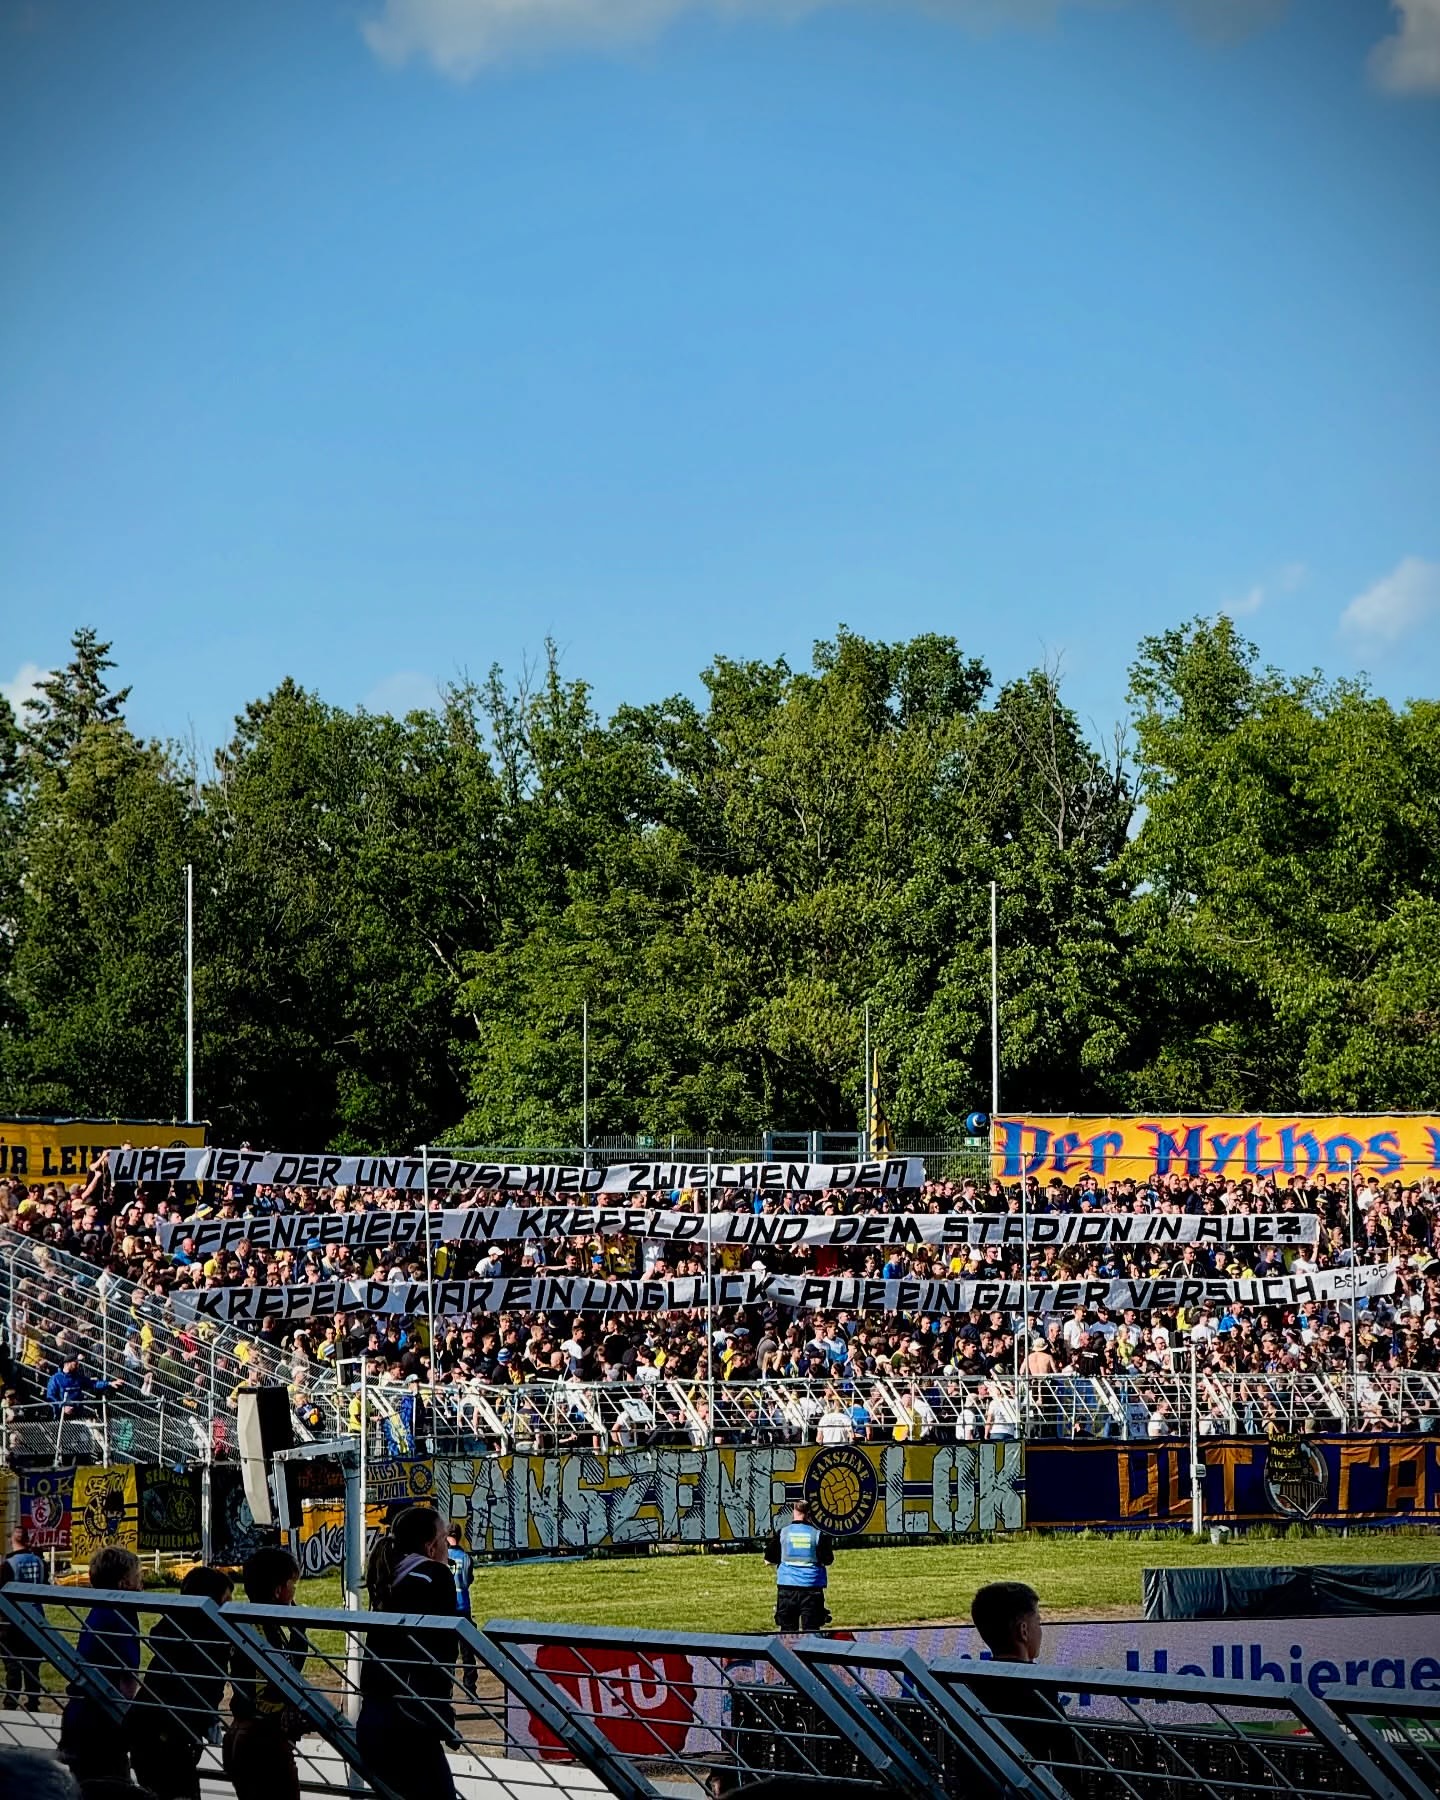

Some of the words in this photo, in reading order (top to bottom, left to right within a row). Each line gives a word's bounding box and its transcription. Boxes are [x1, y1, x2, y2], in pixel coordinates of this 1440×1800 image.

[994, 1119, 1125, 1177] Der
[1136, 1122, 1407, 1178] Mythos
[114, 1151, 186, 1181] WAS
[206, 1151, 264, 1182] IST
[273, 1156, 339, 1186] DER
[355, 1158, 609, 1193] UNTERSCHIED
[628, 1163, 809, 1192] ZWISCHEN
[828, 1159, 908, 1190] DEM
[459, 1209, 500, 1240] IN
[517, 1207, 705, 1241] KREFELD
[725, 1214, 809, 1245] UND
[828, 1215, 924, 1245] DEM
[942, 1216, 1134, 1244] STADION
[1144, 1216, 1183, 1242] IN
[1196, 1216, 1302, 1243] AUE?
[194, 1281, 390, 1322] KREFELD
[404, 1280, 495, 1314] WAR
[496, 1279, 575, 1312] EIN
[896, 1280, 961, 1311] EIN
[970, 1282, 1111, 1311] GUTER
[1126, 1275, 1328, 1307] VERSUCH.
[20, 1475, 73, 1497] LOK
[811, 1451, 871, 1481] FANSZENE
[880, 1442, 1024, 1534] LOK
[432, 1448, 798, 1551] FANSZENE
